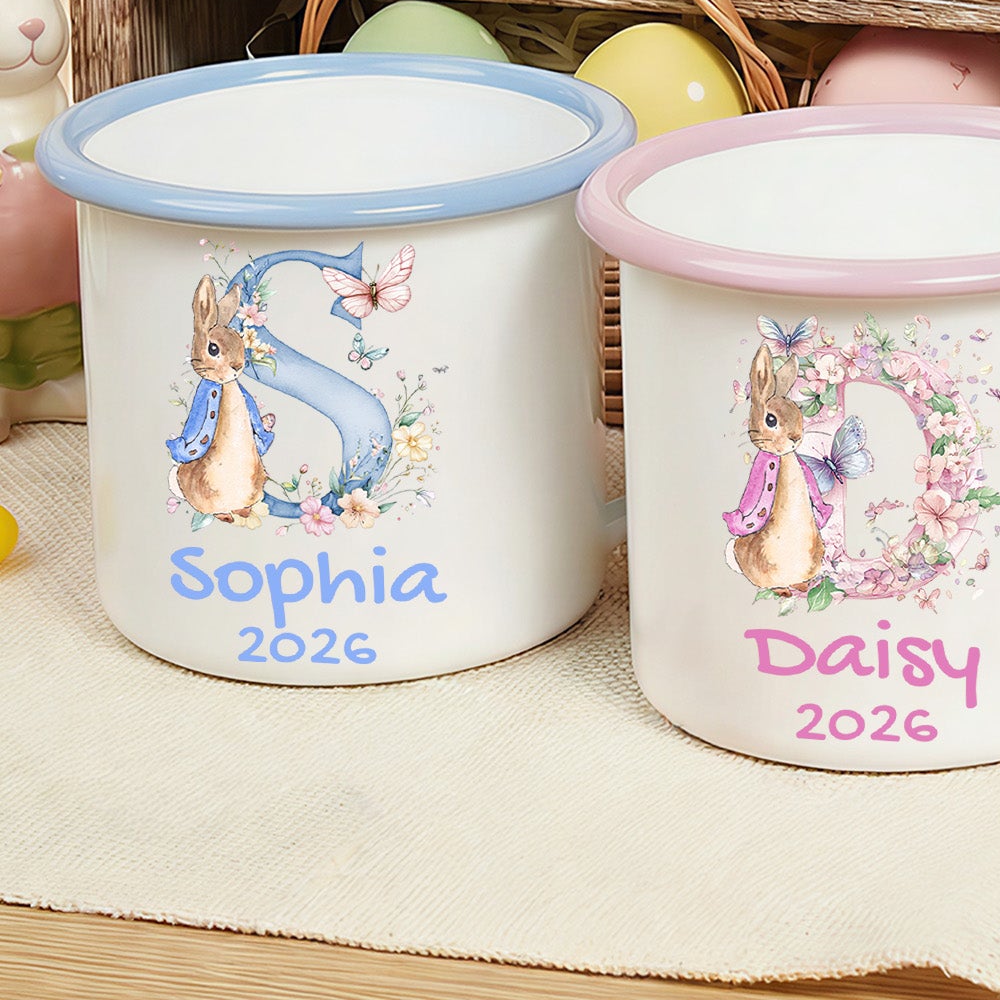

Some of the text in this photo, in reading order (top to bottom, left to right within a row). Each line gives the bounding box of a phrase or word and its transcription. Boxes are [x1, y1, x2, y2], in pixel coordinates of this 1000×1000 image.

[222, 241, 395, 521] S
[795, 334, 985, 600] D
[169, 545, 448, 629] Sophia
[237, 626, 377, 665] 2026
[743, 619, 982, 709] Daisy
[795, 703, 938, 743] 2026
